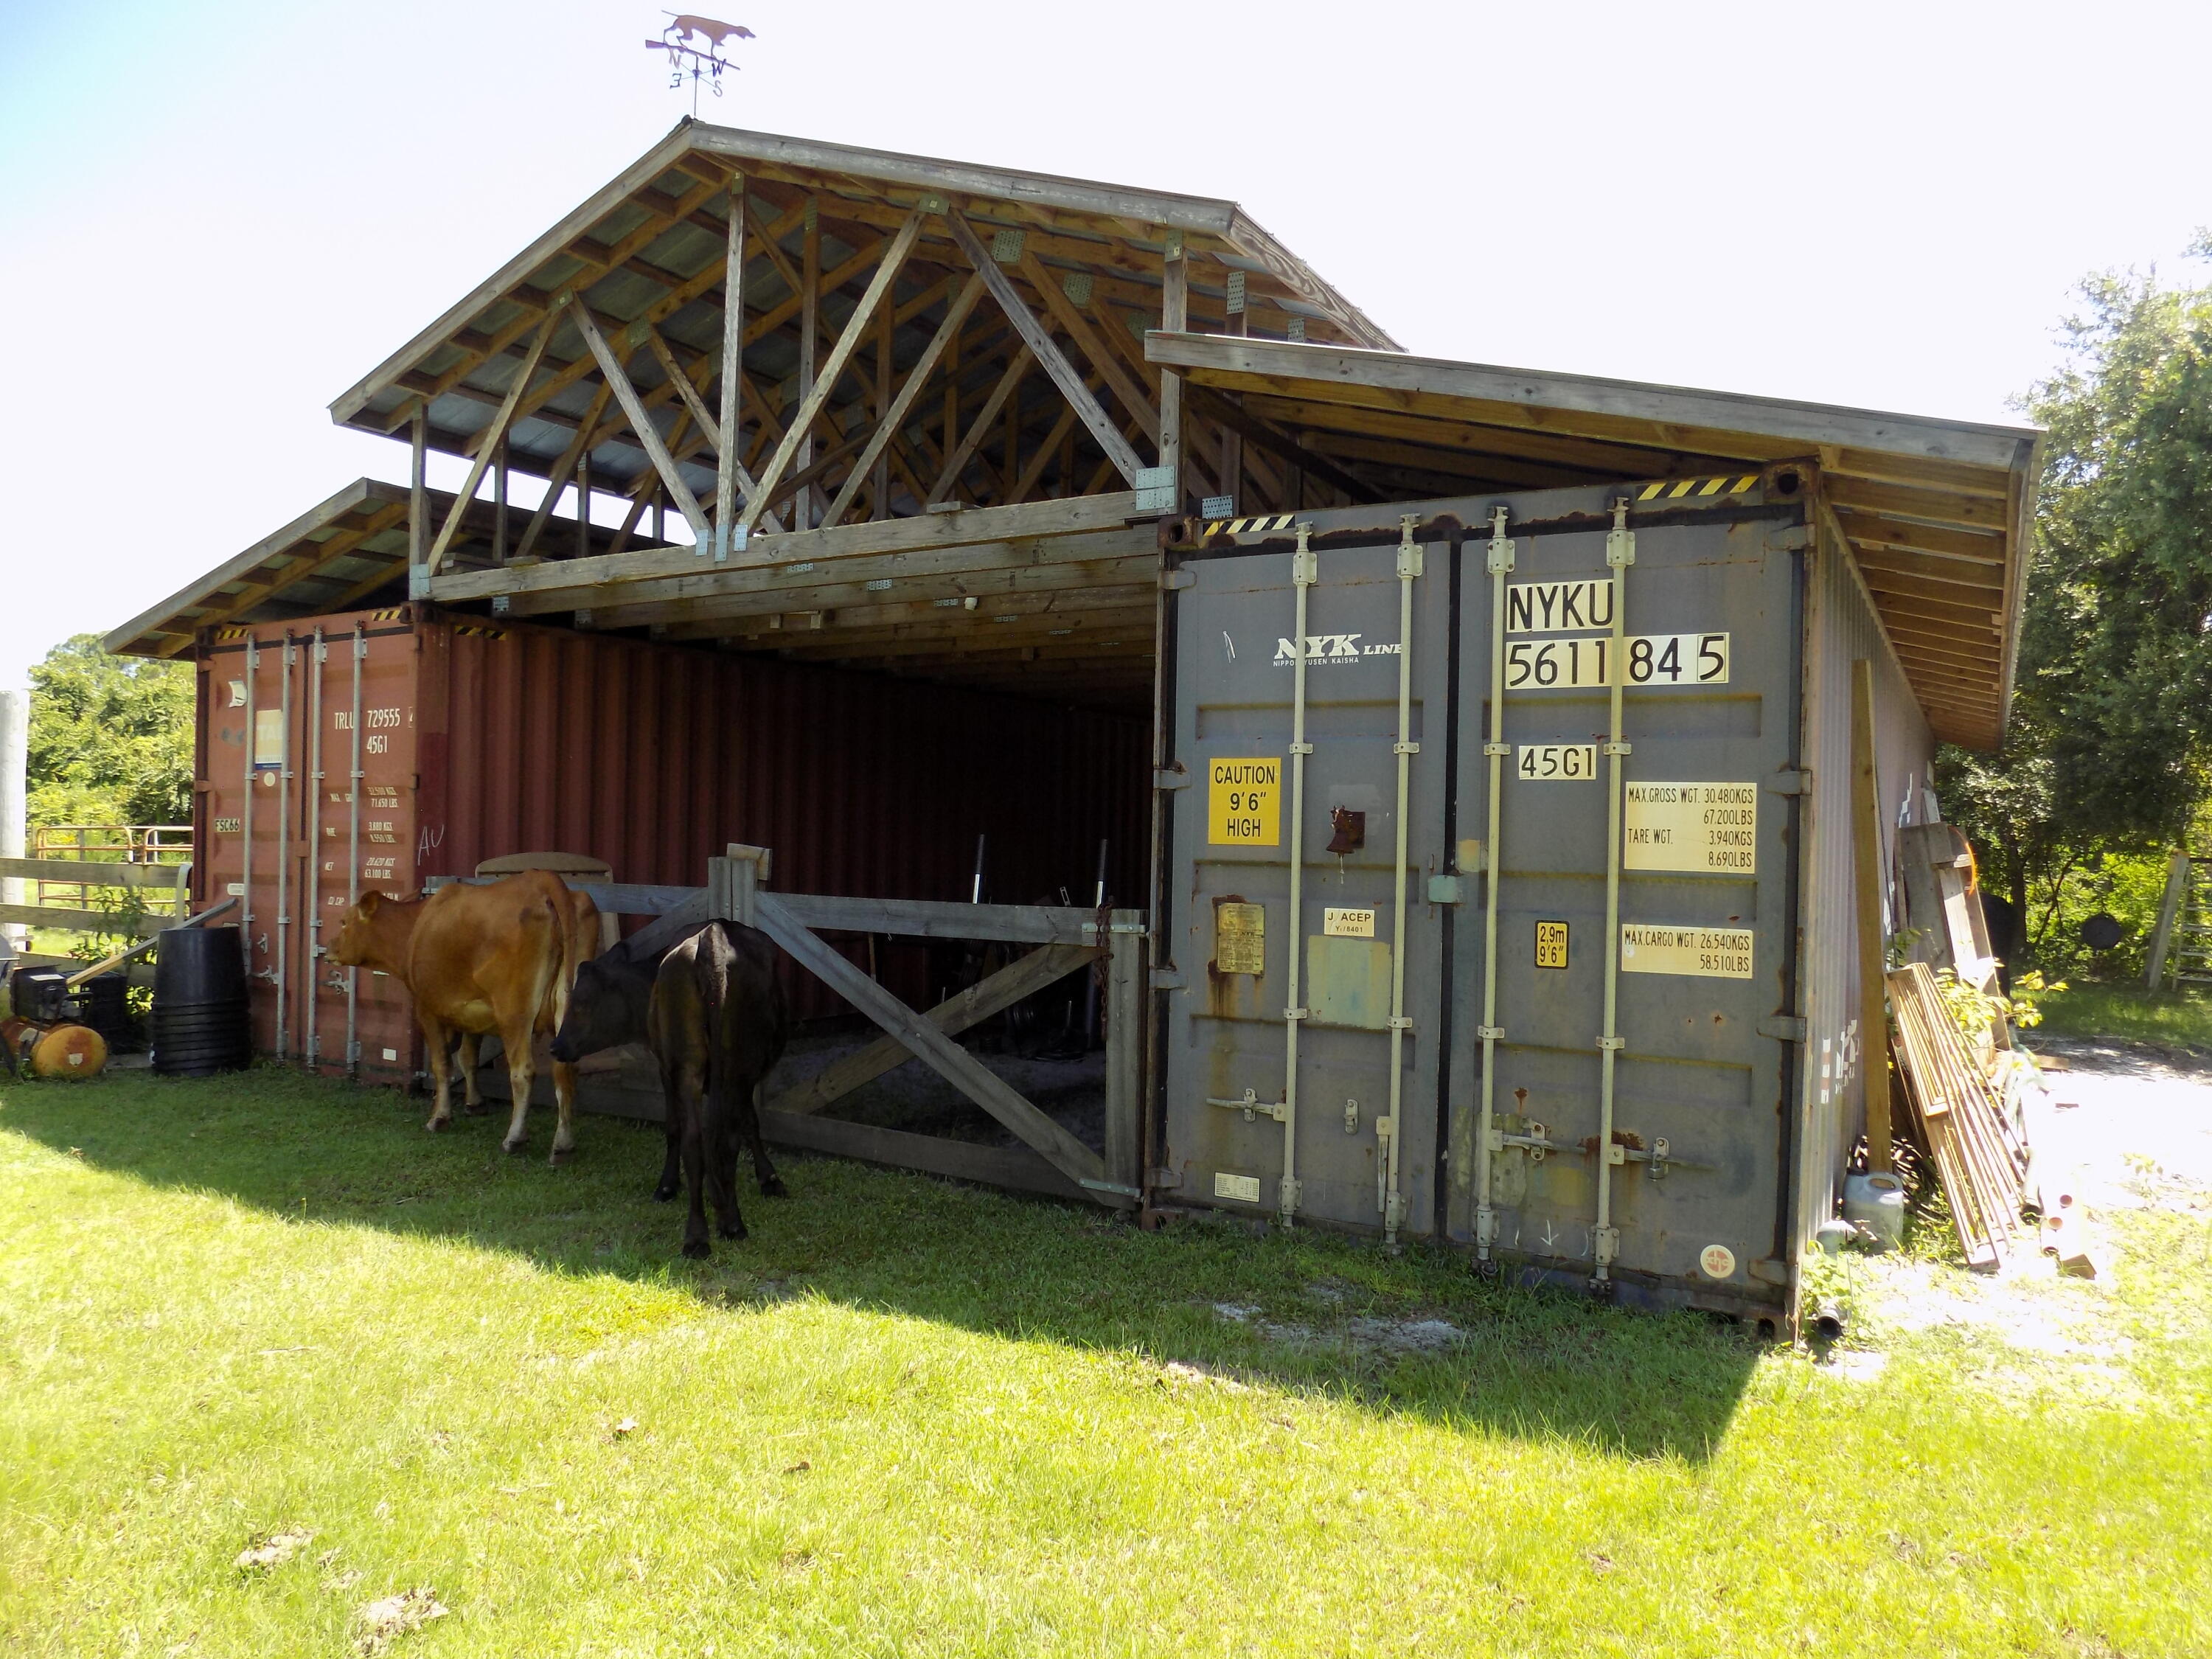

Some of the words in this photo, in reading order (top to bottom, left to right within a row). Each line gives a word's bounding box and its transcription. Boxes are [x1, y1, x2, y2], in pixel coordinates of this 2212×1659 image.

[668, 48, 682, 70] N
[712, 58, 726, 77] W
[712, 80, 723, 97] S
[1509, 582, 1613, 630] NYKU
[1273, 633, 1362, 660] NYK
[1363, 643, 1402, 655] LINE
[1273, 658, 1296, 667] NIPPO
[334, 711, 354, 730] TRLU
[367, 708, 401, 728] 729555
[366, 735, 388, 754] 45G1
[1521, 747, 1593, 777] 45G1
[1214, 765, 1275, 785] CAUTION
[1680, 787, 1700, 804] WGT.
[1227, 818, 1261, 838] HIGH
[1628, 829, 1649, 844] TARE
[1653, 830, 1673, 845] WGT.
[1328, 912, 1334, 921] J
[1340, 912, 1371, 922] ACEP
[1677, 932, 1697, 948] WGT.
